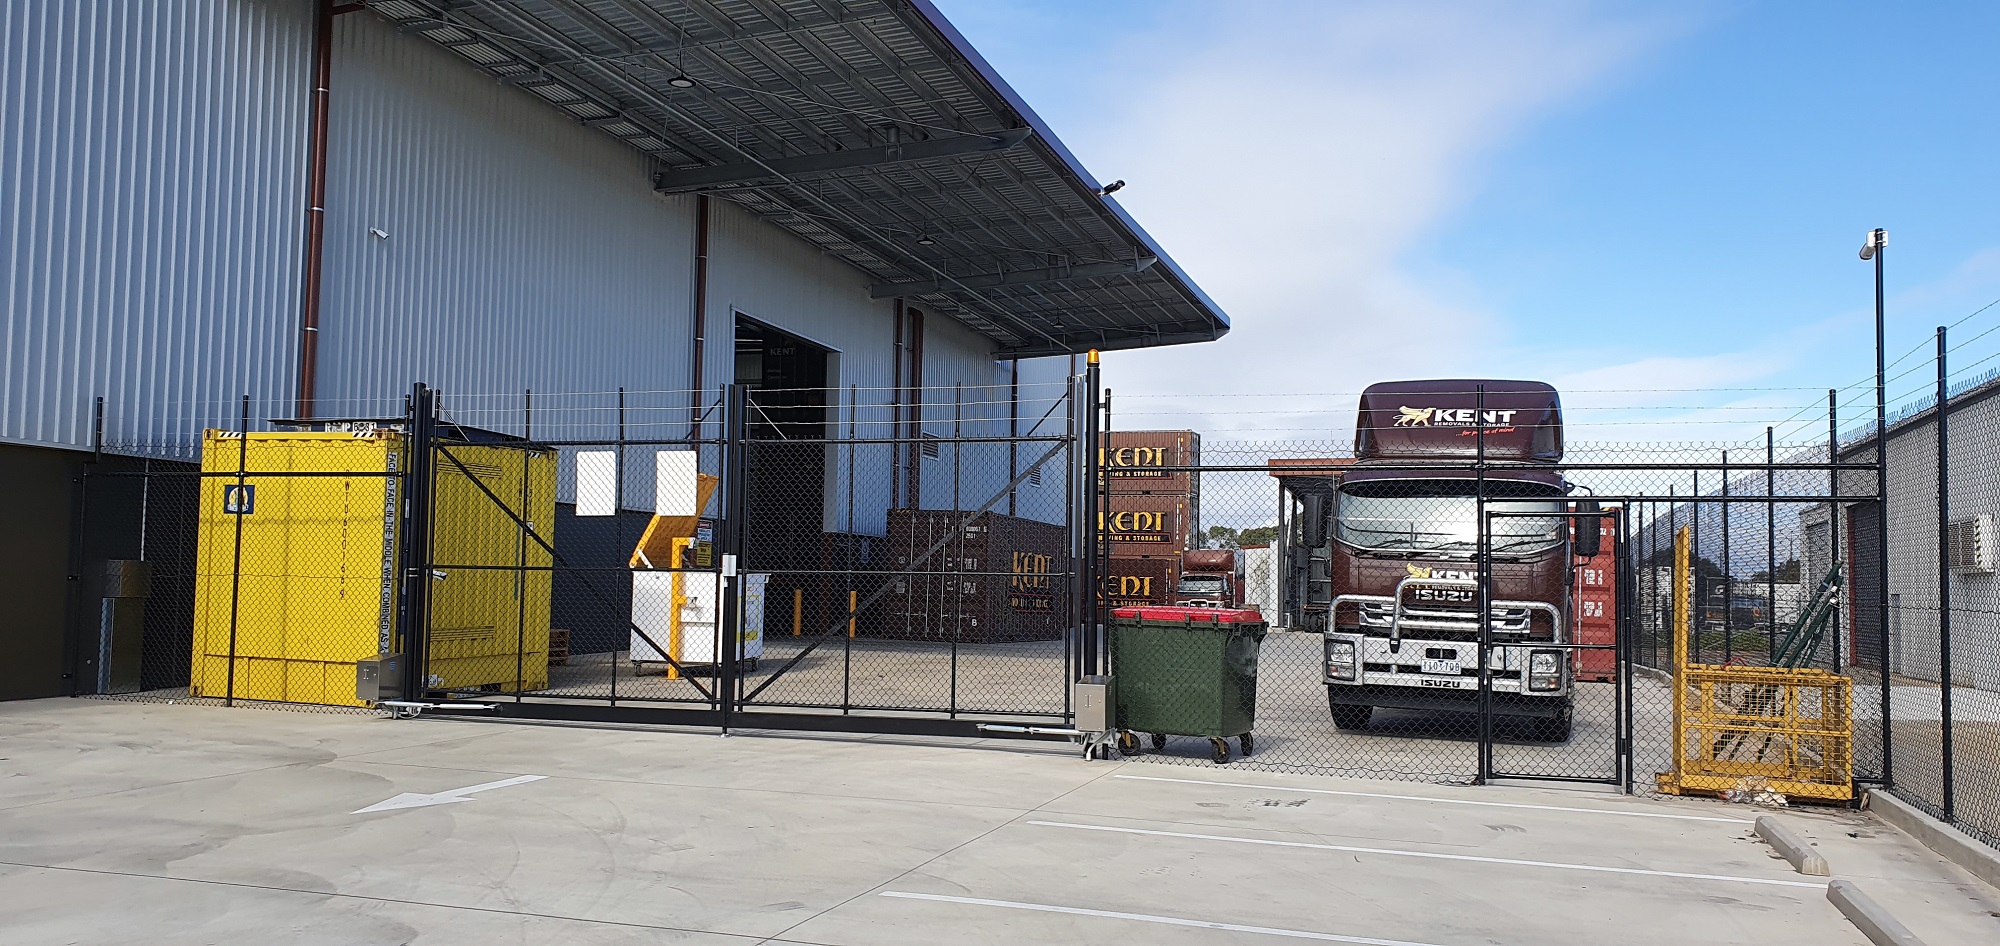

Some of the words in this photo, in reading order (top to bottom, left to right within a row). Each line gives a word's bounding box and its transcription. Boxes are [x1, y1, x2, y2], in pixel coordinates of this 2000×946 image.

[769, 347, 796, 356] KENT
[1434, 409, 1516, 423] KENT
[1472, 428, 1490, 437] pece
[388, 453, 397, 472] FACE
[1098, 447, 1166, 467] KENT
[386, 488, 395, 507] FACE
[386, 510, 394, 518] IN
[1098, 511, 1165, 533] KENT
[385, 521, 393, 535] THE
[384, 538, 393, 564] MIDDLE
[383, 567, 391, 588] WHEN
[1415, 589, 1473, 602] ISUZU
[381, 592, 391, 630] COMBINED
[1420, 679, 1460, 688] ISUZU
